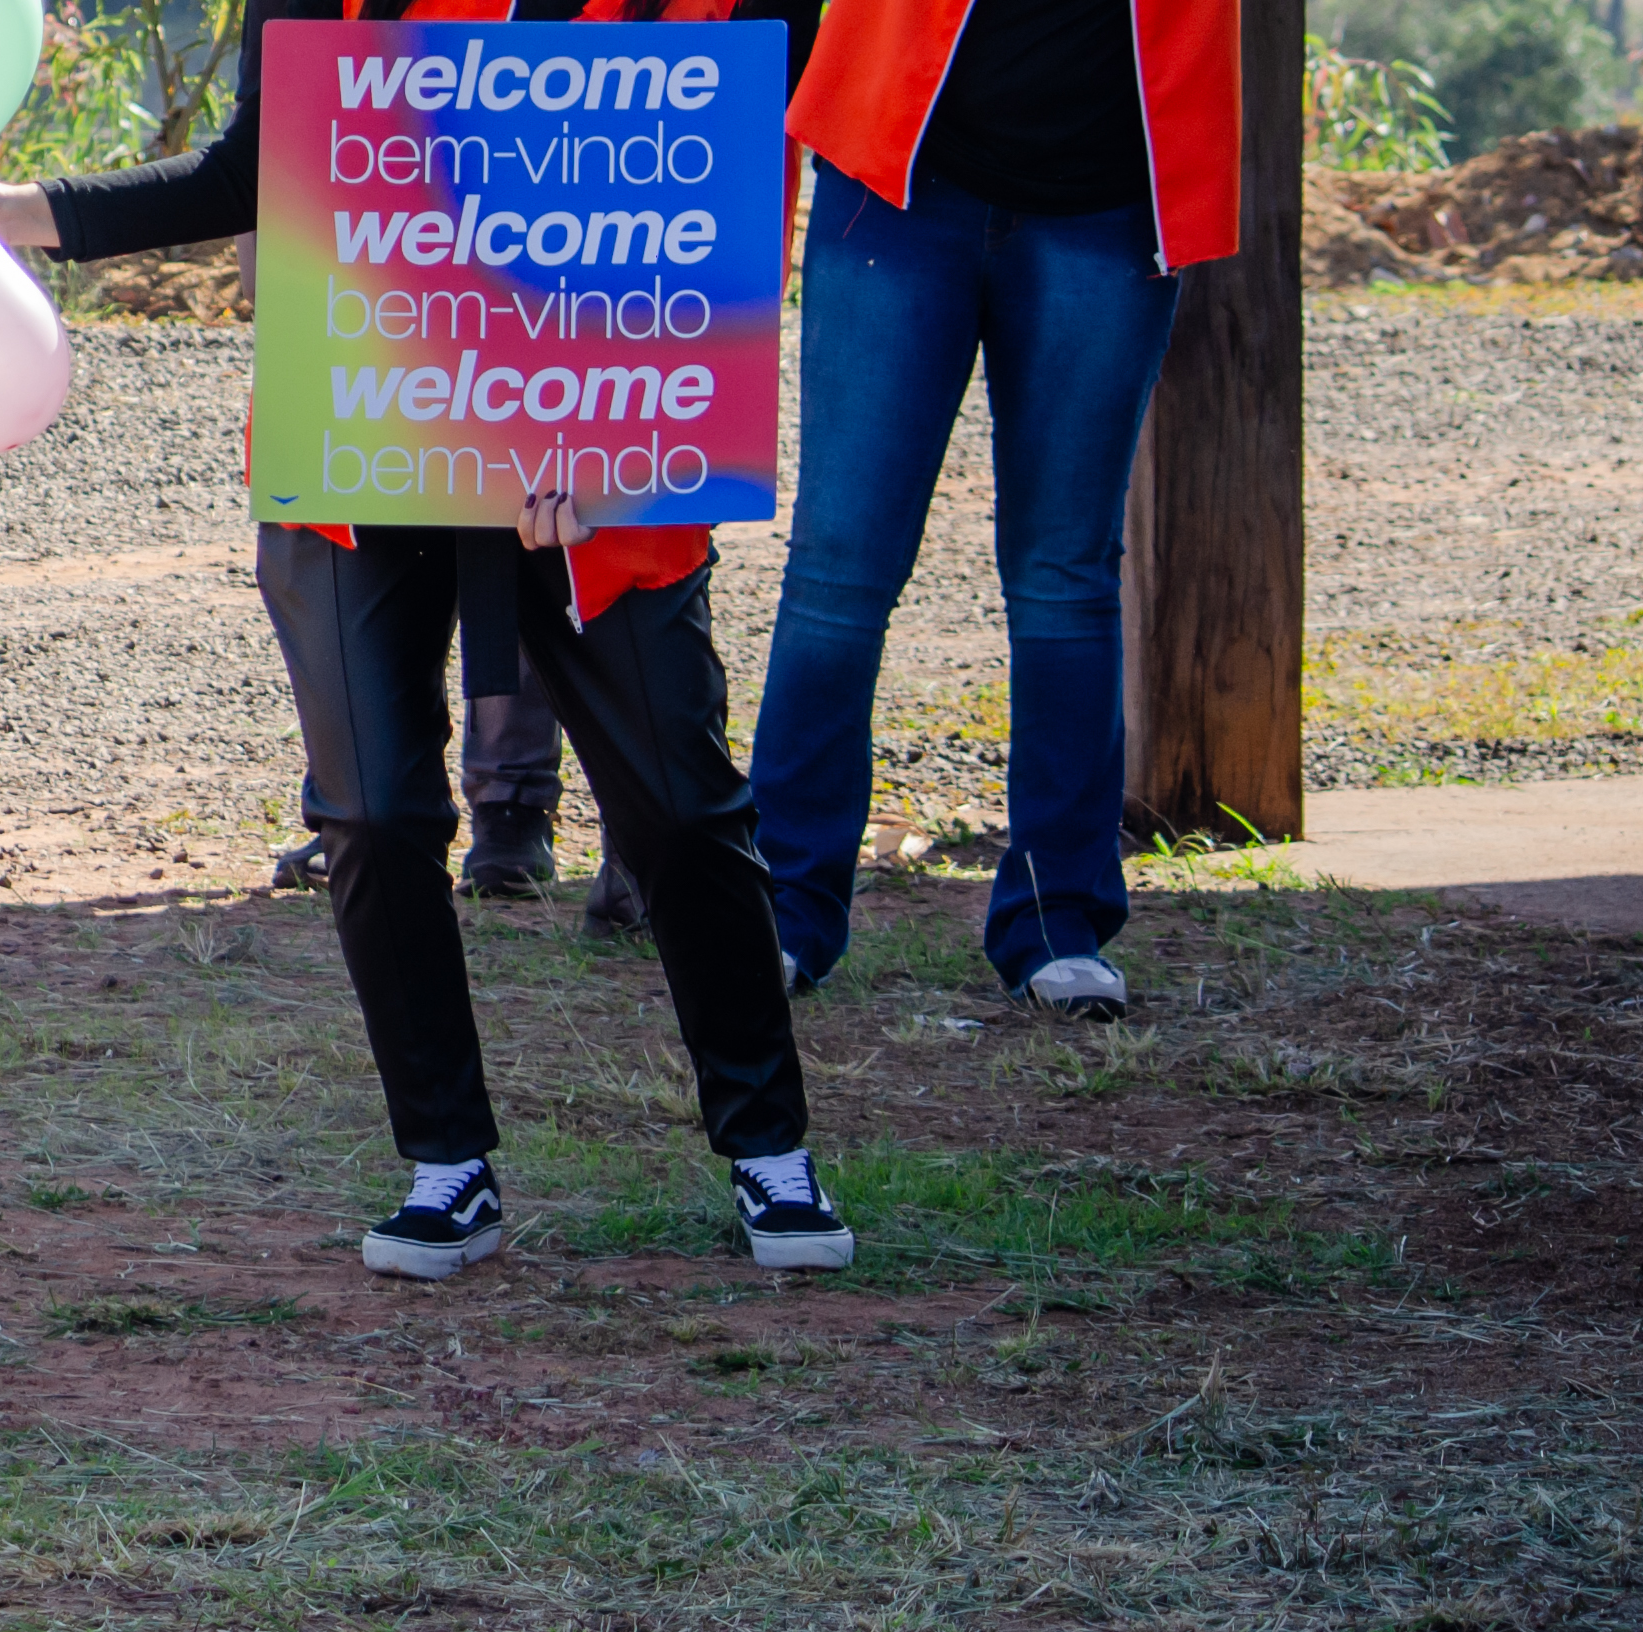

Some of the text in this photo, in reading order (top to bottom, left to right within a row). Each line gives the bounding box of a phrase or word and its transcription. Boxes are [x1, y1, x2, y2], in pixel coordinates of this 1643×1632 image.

[337, 39, 719, 112] welcome
[330, 120, 713, 184] bem-vindo
[334, 194, 716, 266] welcome
[327, 275, 710, 339] bem-vindo
[330, 350, 714, 422] welcome
[322, 430, 707, 495] bem-vindo
